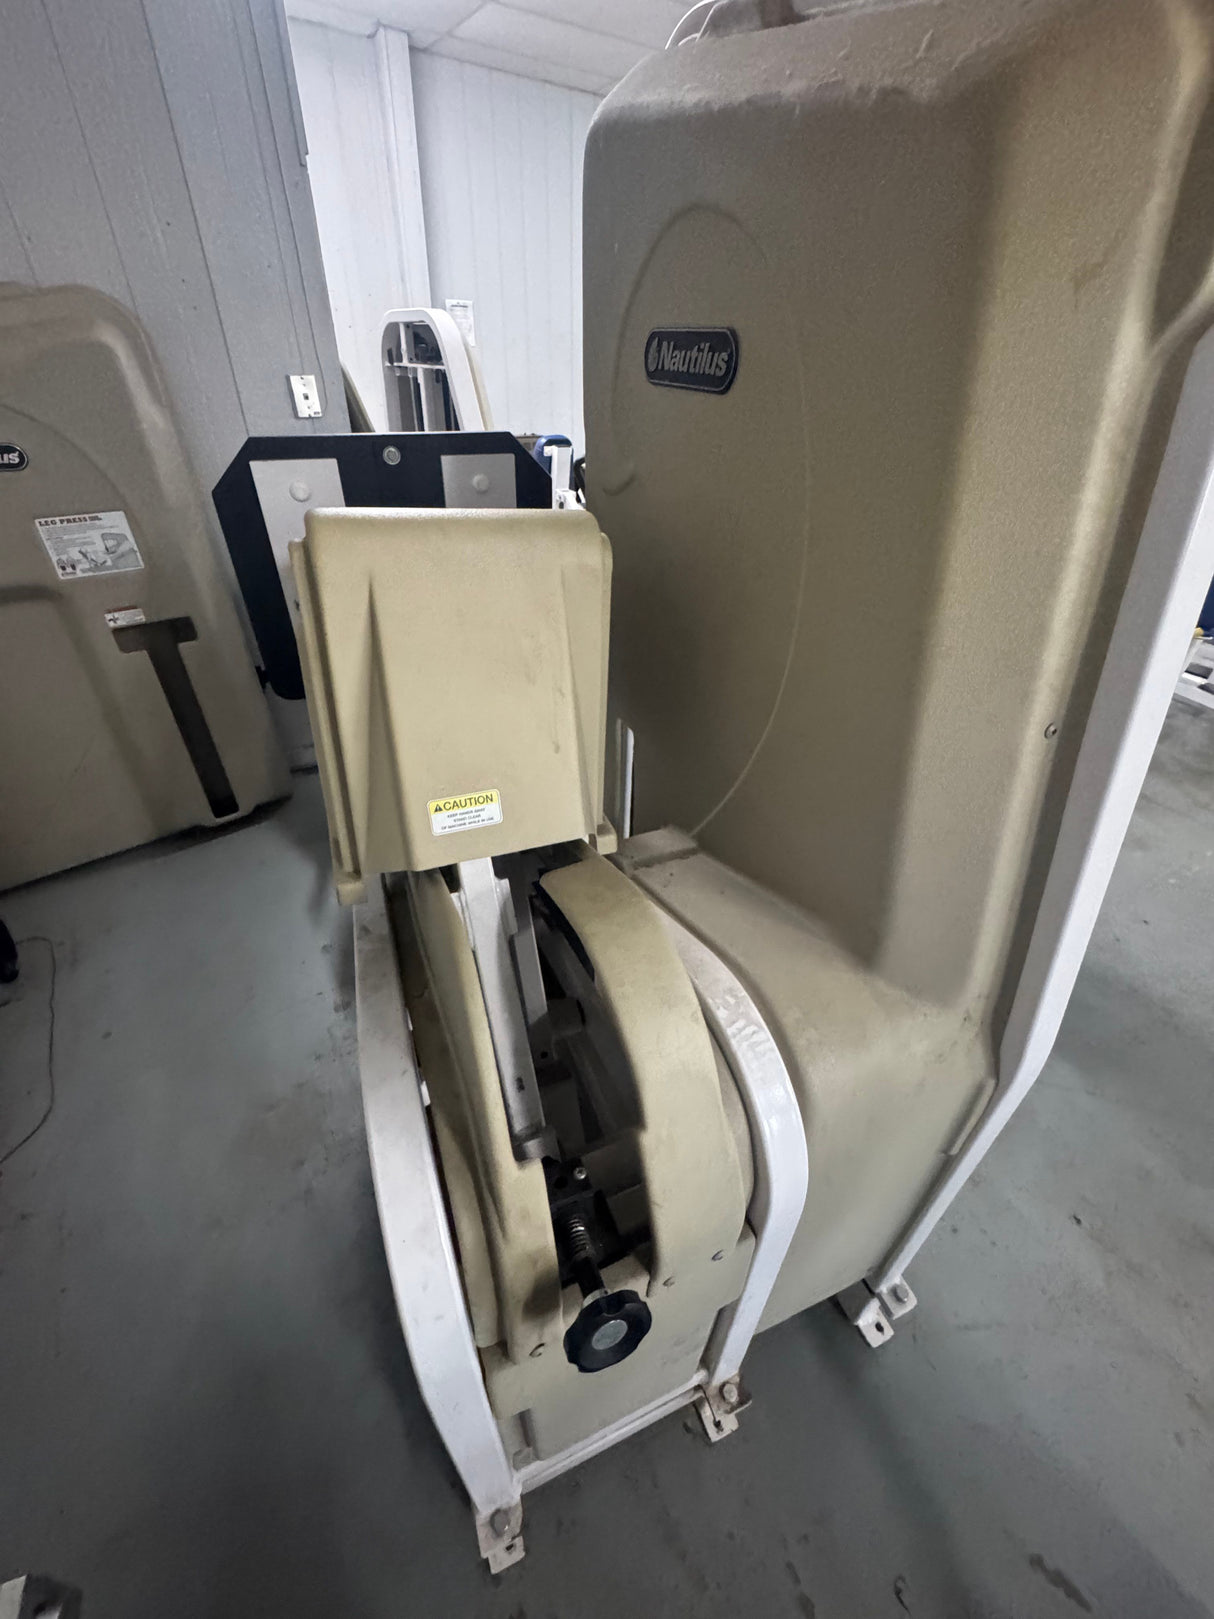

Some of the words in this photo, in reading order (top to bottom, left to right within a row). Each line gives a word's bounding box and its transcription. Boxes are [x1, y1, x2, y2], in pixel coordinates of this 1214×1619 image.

[658, 341, 729, 376] Nautilus
[38, 519, 57, 527] LEG
[59, 516, 88, 525] PRESS
[443, 793, 494, 811] CAUTION
